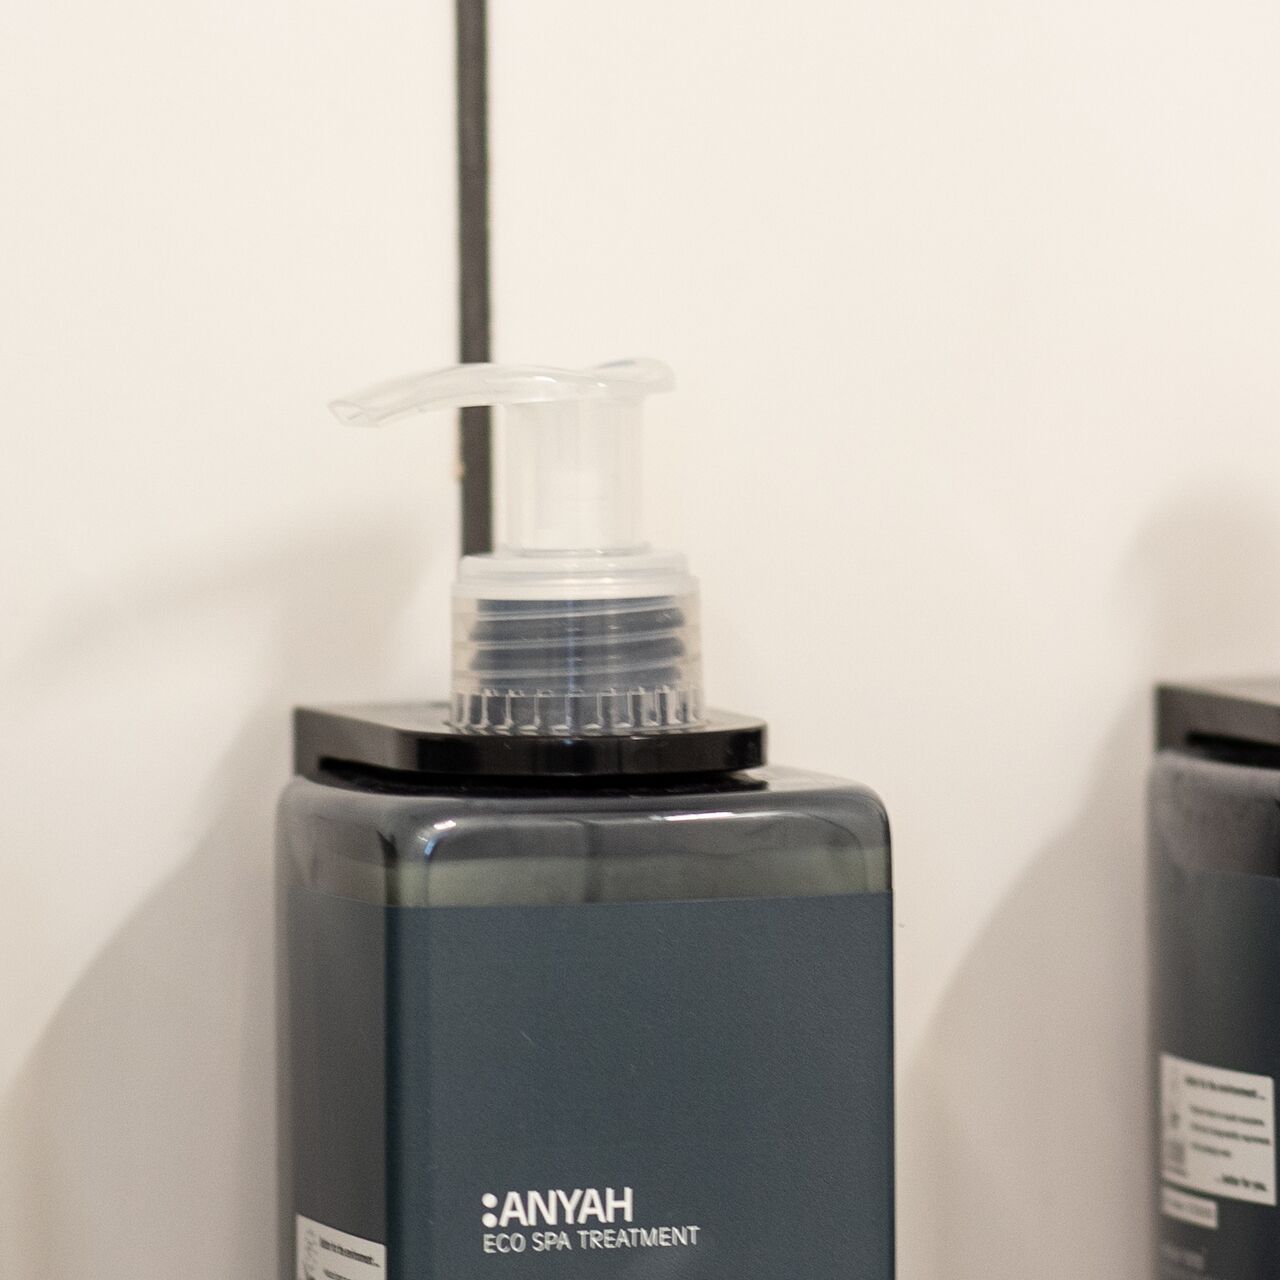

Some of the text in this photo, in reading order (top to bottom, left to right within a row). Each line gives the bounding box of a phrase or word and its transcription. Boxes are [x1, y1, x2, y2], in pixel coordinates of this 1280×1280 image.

[483, 1226, 699, 1253] ECO SPA TREATMENT
